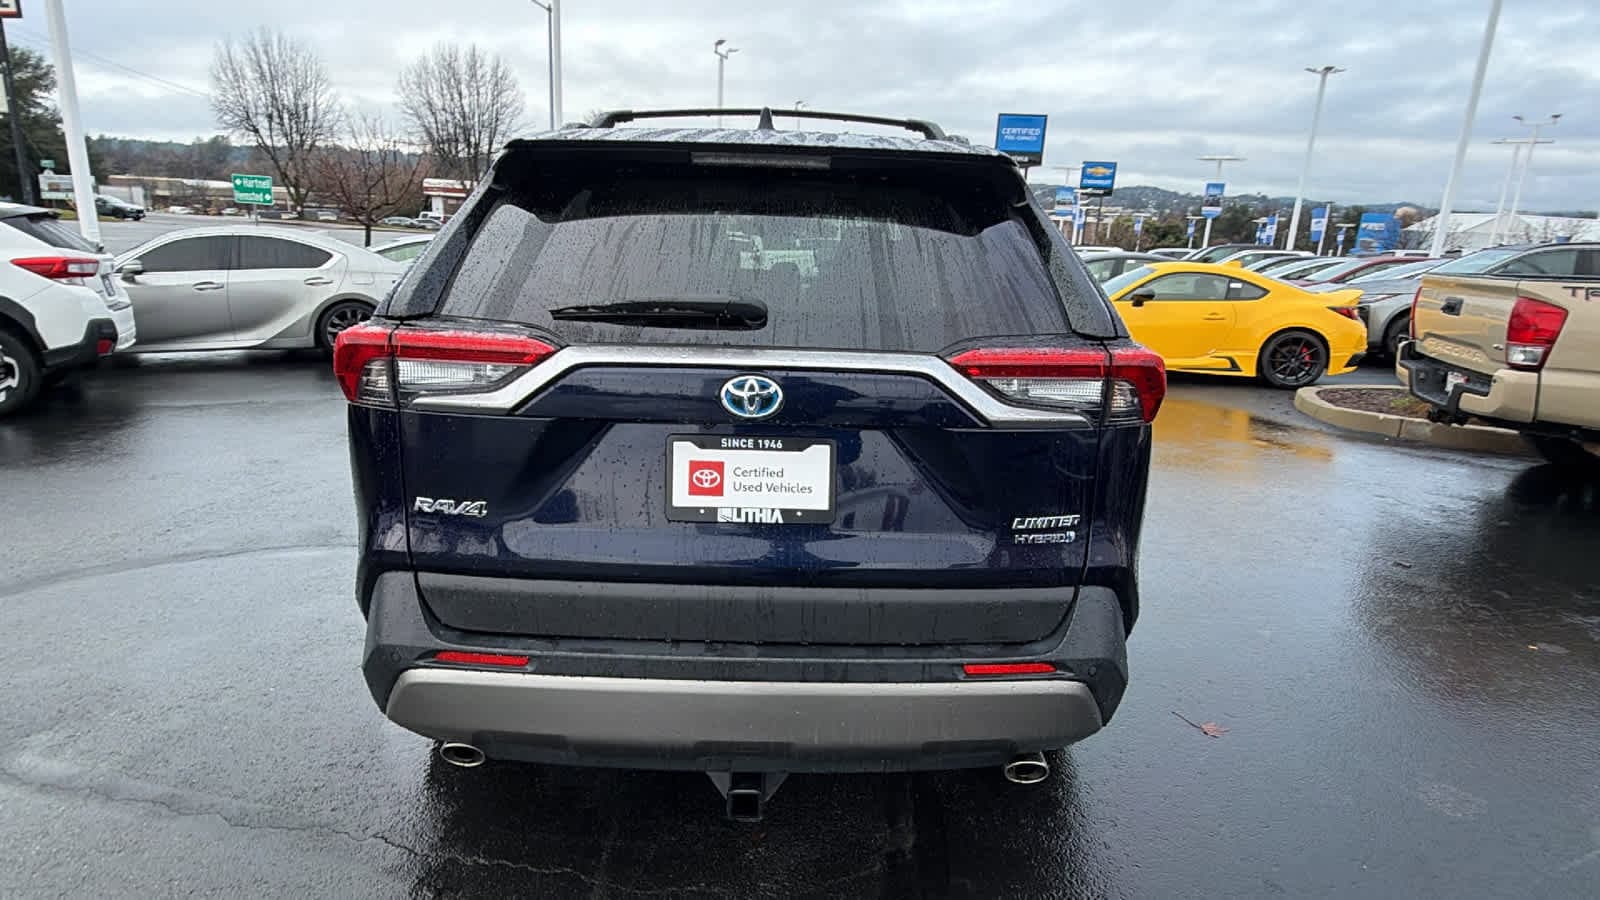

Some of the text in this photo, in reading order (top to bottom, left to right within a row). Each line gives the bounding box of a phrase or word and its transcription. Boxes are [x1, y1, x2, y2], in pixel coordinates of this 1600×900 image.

[720, 438, 783, 449] SINCE 1946
[732, 466, 784, 478] Certified
[732, 481, 813, 494] Used Vehicles
[413, 496, 488, 518] RAV4
[731, 508, 783, 524] LITHIA
[1014, 532, 1065, 544] HYBRID
